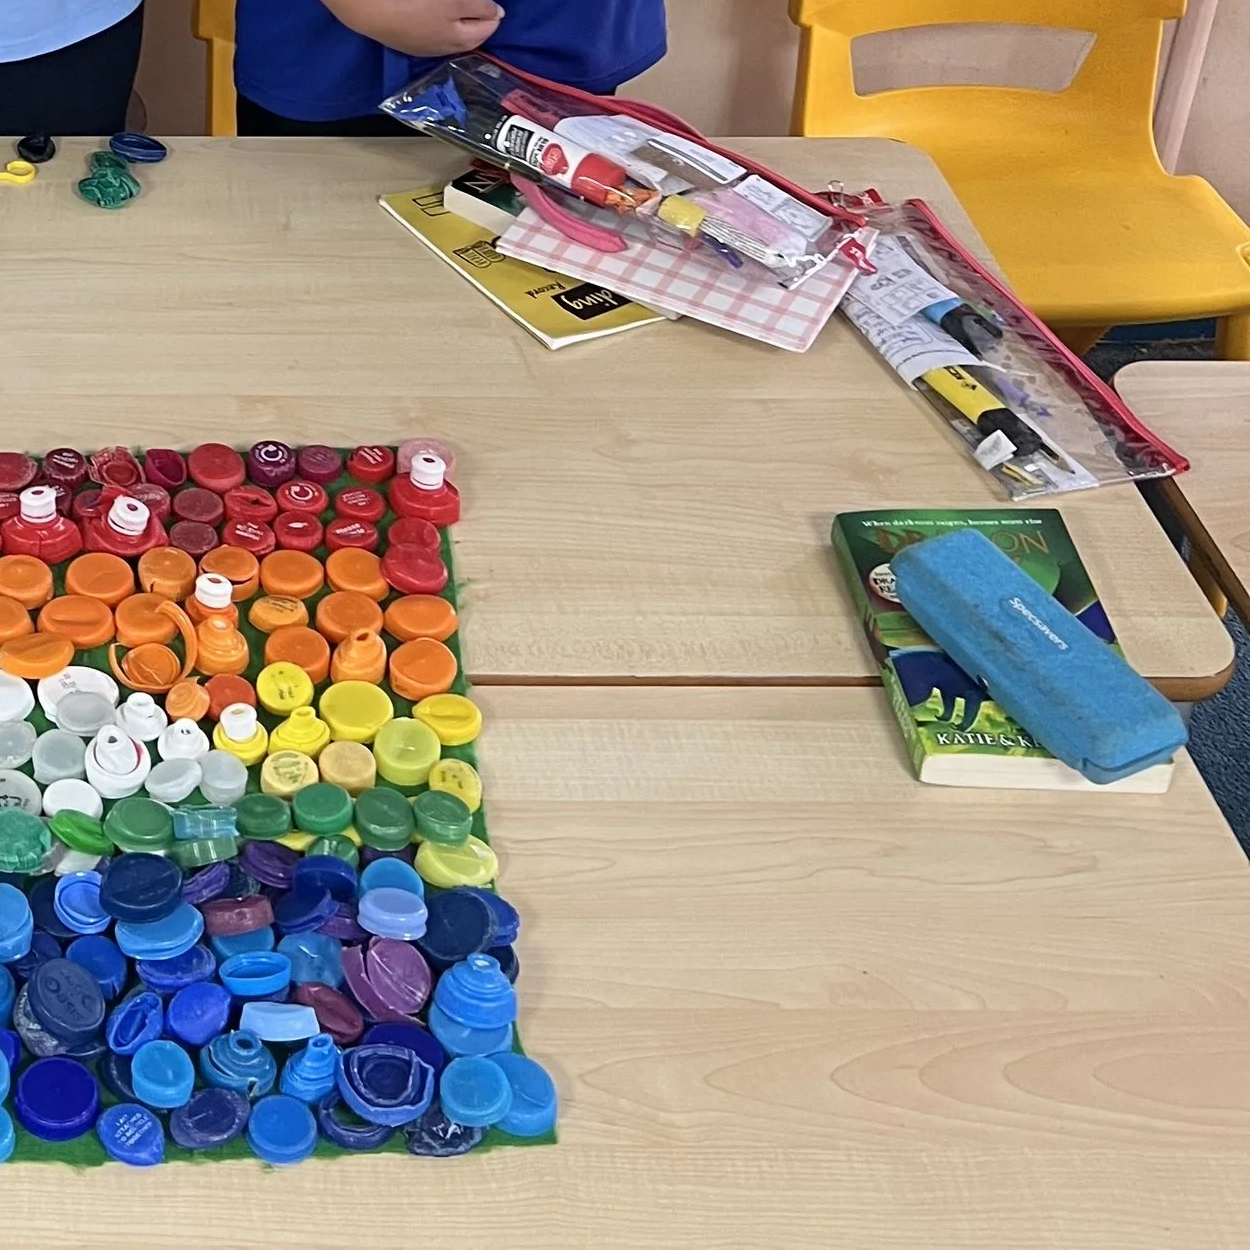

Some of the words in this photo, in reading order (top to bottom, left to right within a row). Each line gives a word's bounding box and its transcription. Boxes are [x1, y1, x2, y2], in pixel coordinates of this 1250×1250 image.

[523, 280, 567, 300] Record
[1008, 596, 1070, 651] Specsavers
[935, 732, 998, 746] KATIE
[999, 733, 1016, 748] &
